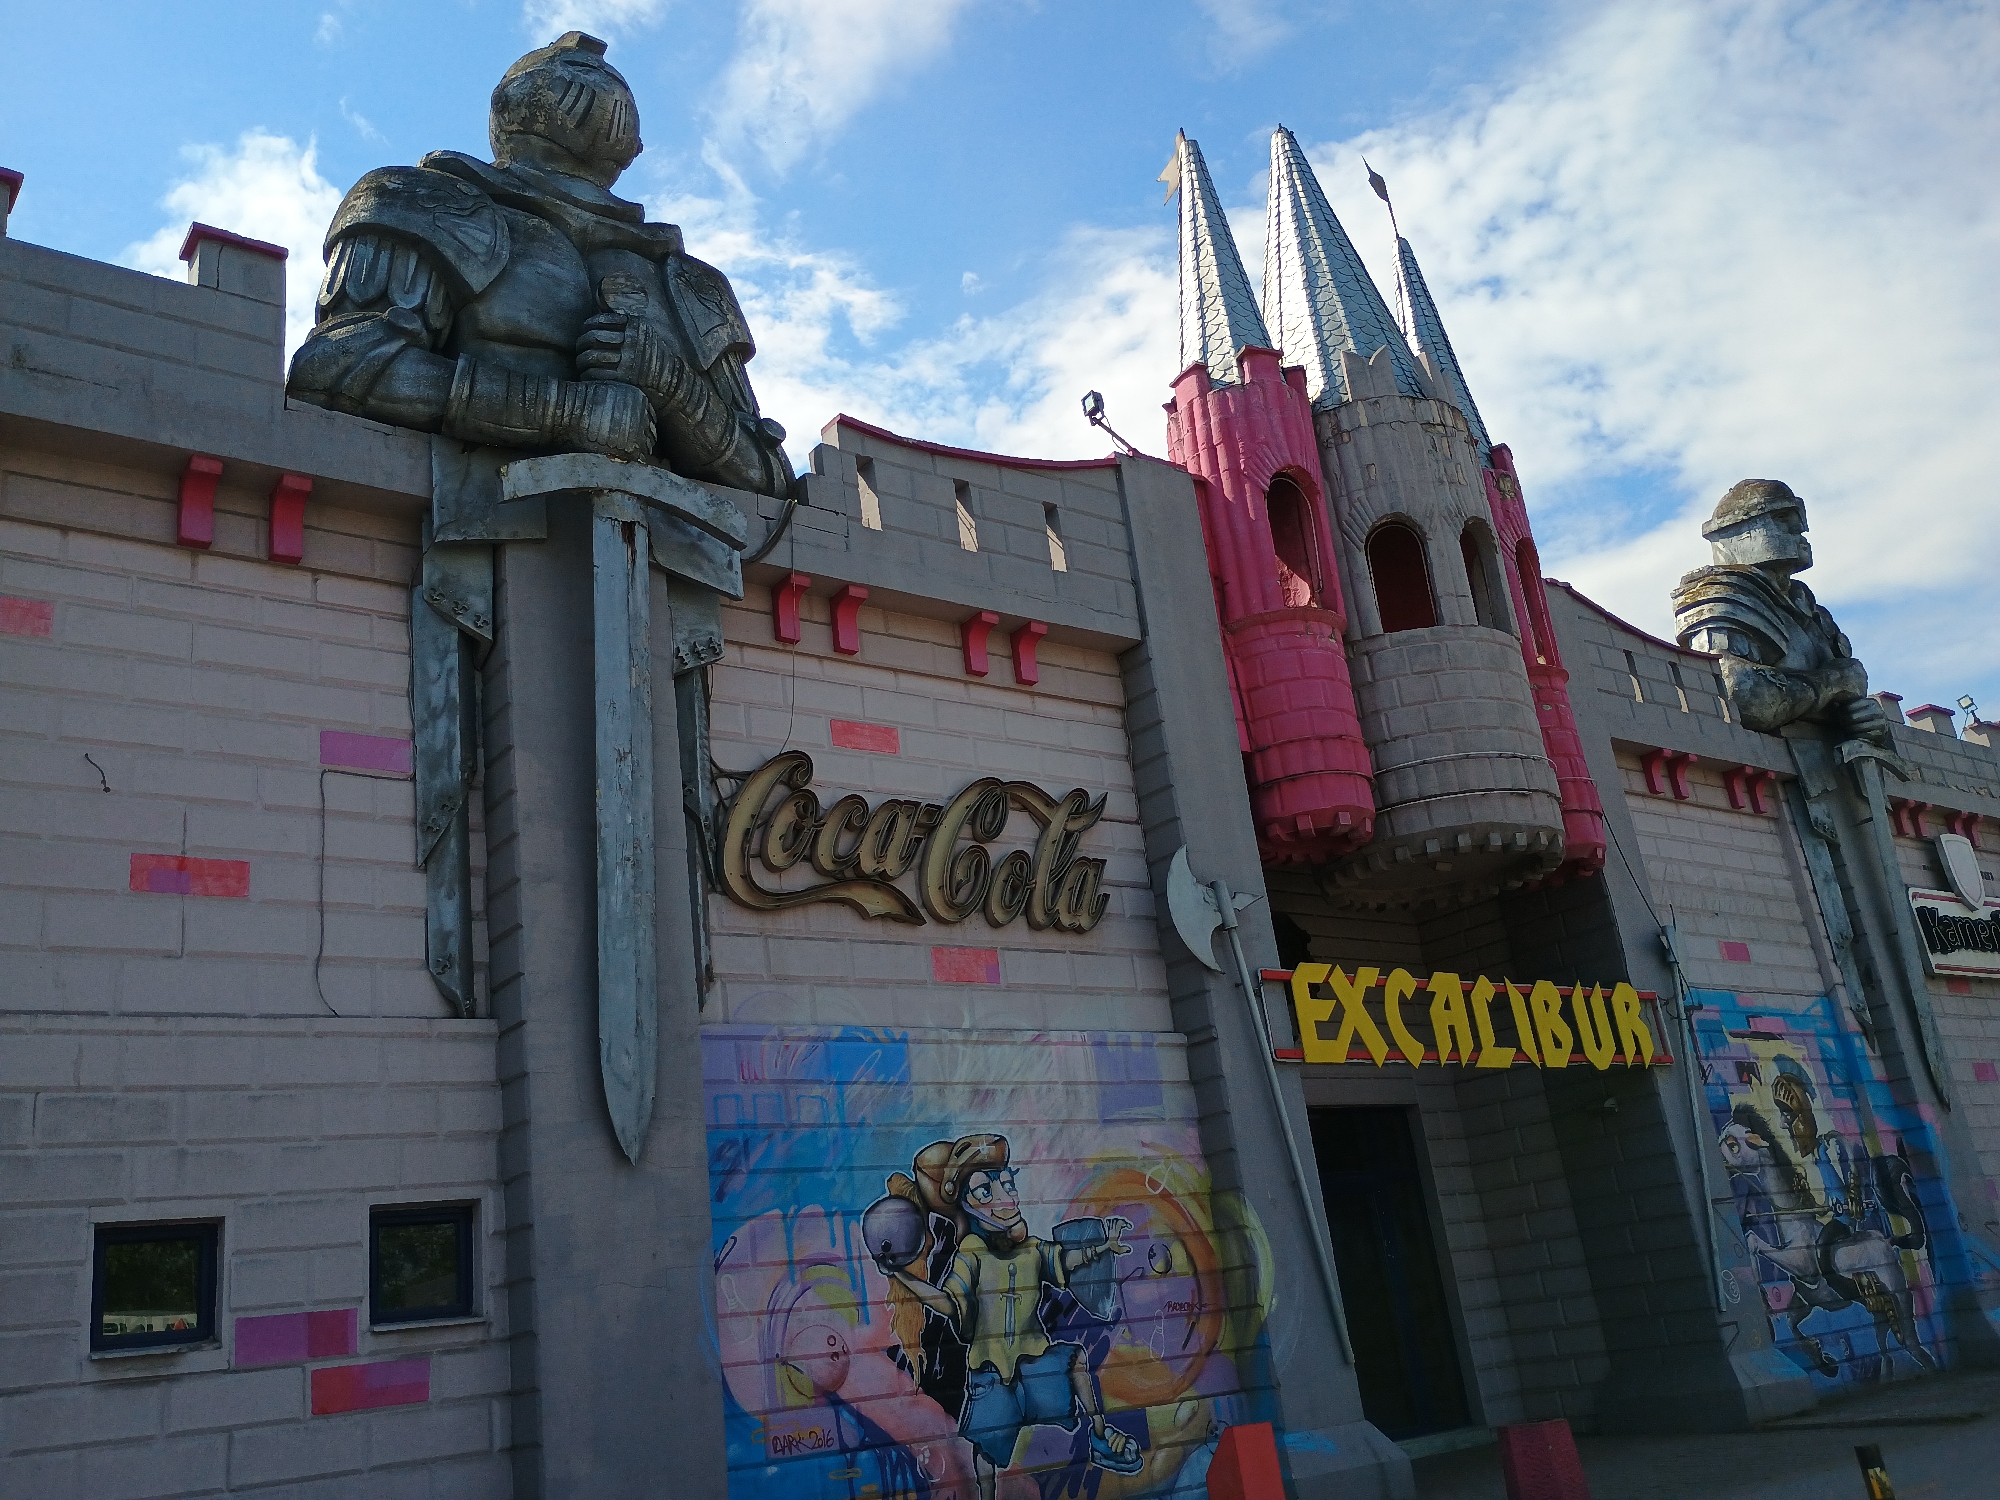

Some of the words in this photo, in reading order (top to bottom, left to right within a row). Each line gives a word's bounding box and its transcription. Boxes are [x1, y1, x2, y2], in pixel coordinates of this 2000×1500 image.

[718, 750, 1109, 934] Coca-Cola
[1291, 962, 1655, 1070] EXCALIBUR
[808, 1429, 835, 1449] 2016
